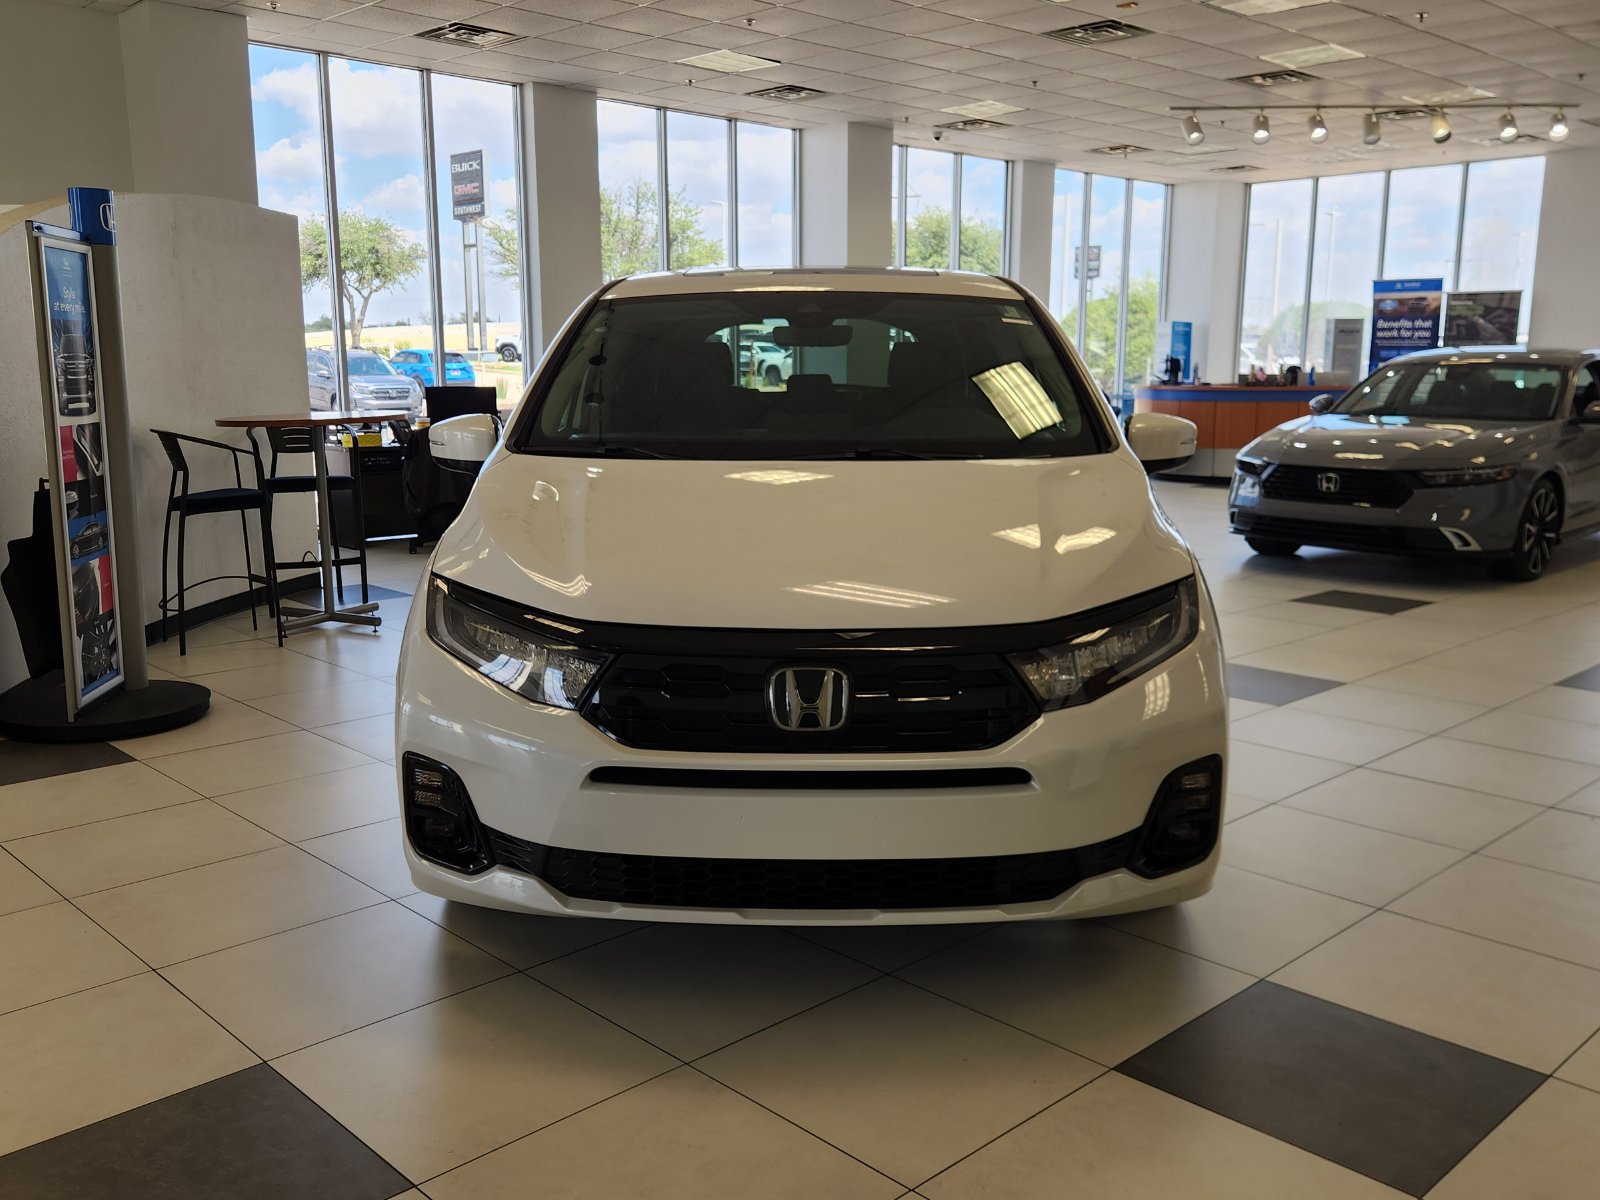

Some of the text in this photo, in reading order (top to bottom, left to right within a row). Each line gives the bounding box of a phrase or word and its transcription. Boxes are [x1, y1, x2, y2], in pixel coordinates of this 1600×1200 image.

[451, 160, 480, 173] BUICK
[453, 183, 480, 196] GMC
[1376, 318, 1433, 328] Benefits that
[1376, 328, 1432, 340] work for you
